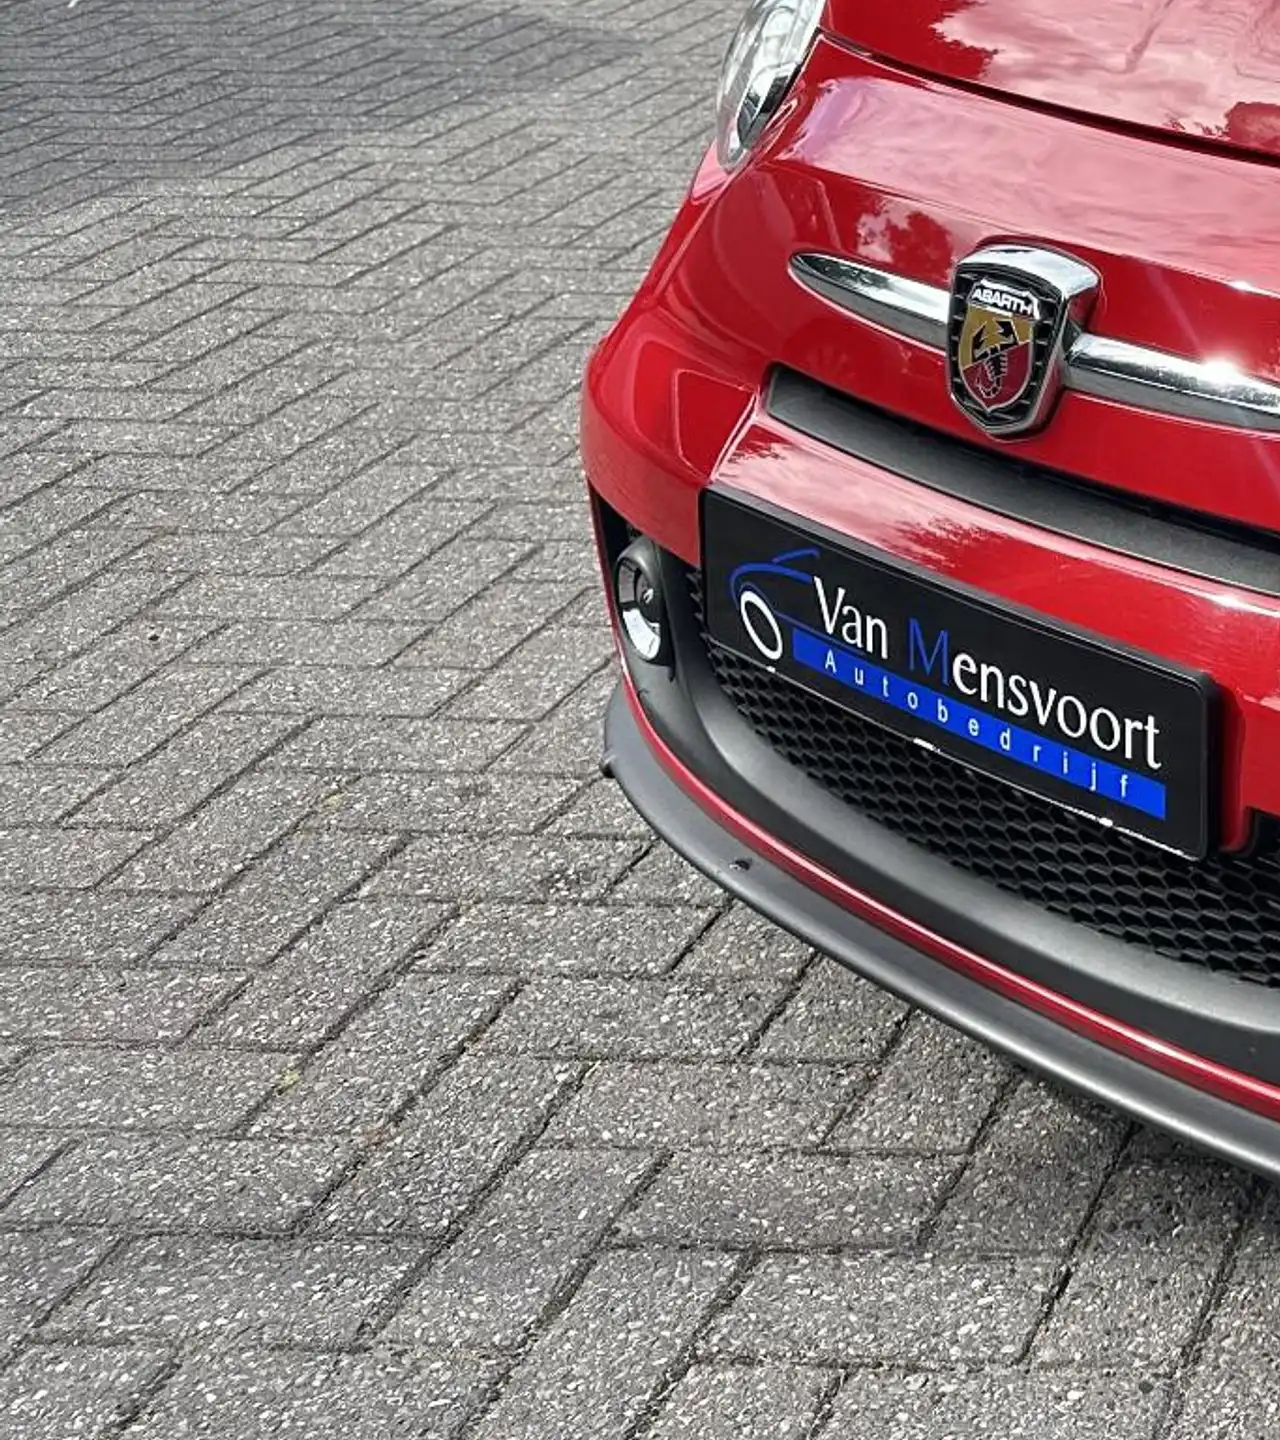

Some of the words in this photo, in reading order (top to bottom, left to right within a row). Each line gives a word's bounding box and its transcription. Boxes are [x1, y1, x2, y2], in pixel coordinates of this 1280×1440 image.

[971, 288, 1034, 315] ABARTH
[813, 575, 890, 660] Van
[908, 617, 1162, 770] Mensvoort
[824, 649, 1129, 799] Autobedrijf
